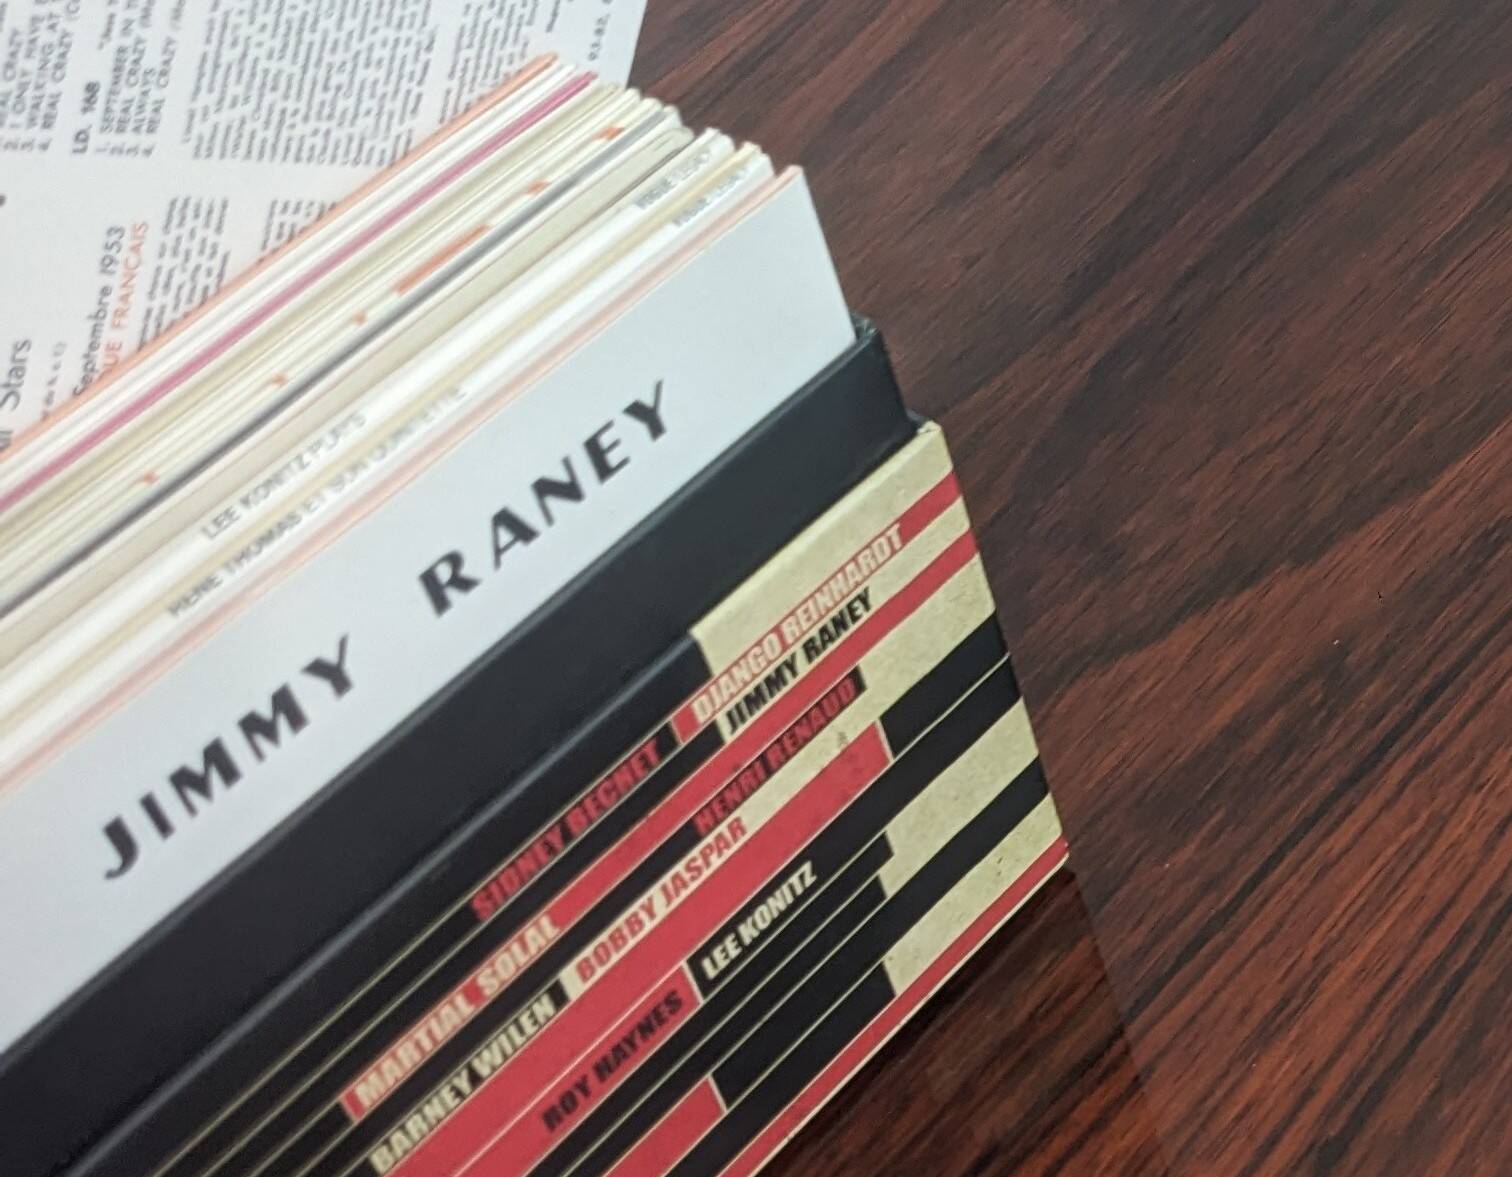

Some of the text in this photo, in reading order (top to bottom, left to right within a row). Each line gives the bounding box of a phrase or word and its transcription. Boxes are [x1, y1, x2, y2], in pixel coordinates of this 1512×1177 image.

[73, 226, 125, 396] Septembre 1953
[202, 506, 240, 539] LEE
[103, 380, 667, 879] JIMMY RANEY
[692, 523, 902, 716] DJANGO REINHARDT
[725, 586, 875, 735] JIMMY RANEY
[471, 740, 664, 922] SIDNEY BECHET
[692, 678, 857, 838] HENRI RENAUD
[574, 816, 750, 985] BOBBY JASPAR
[702, 861, 818, 980] LEE KONITZ
[354, 914, 561, 1108] MARTIAL SOLAL
[367, 994, 558, 1176] BARNEY WILEN
[540, 988, 683, 1133] ROY HAYNES
